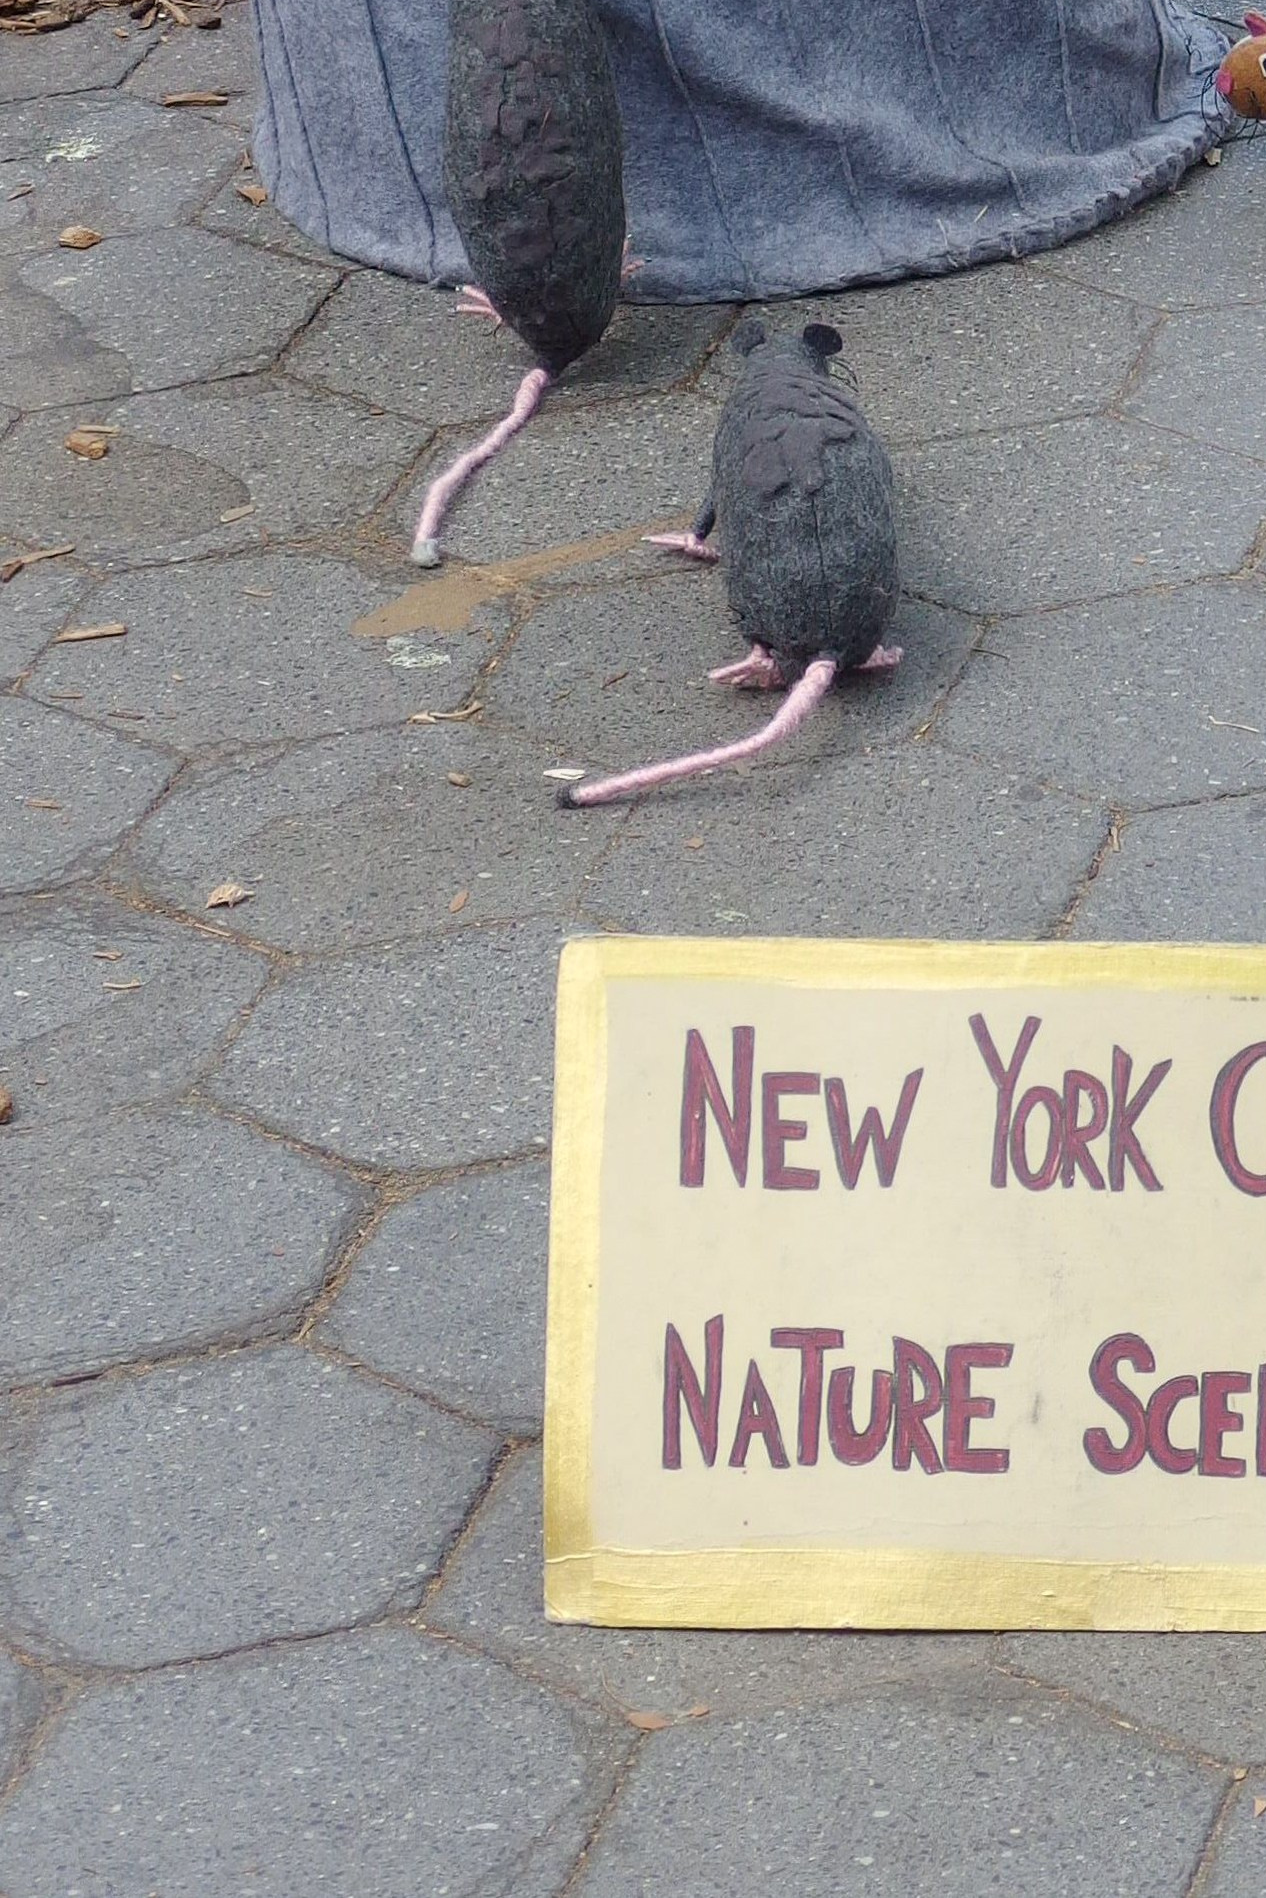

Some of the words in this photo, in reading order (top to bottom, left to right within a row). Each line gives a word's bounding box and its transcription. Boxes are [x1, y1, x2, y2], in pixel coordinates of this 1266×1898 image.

[681, 1026, 923, 1190] NEW
[970, 1014, 1172, 1191] YORK
[663, 1315, 1013, 1475] NATURE
